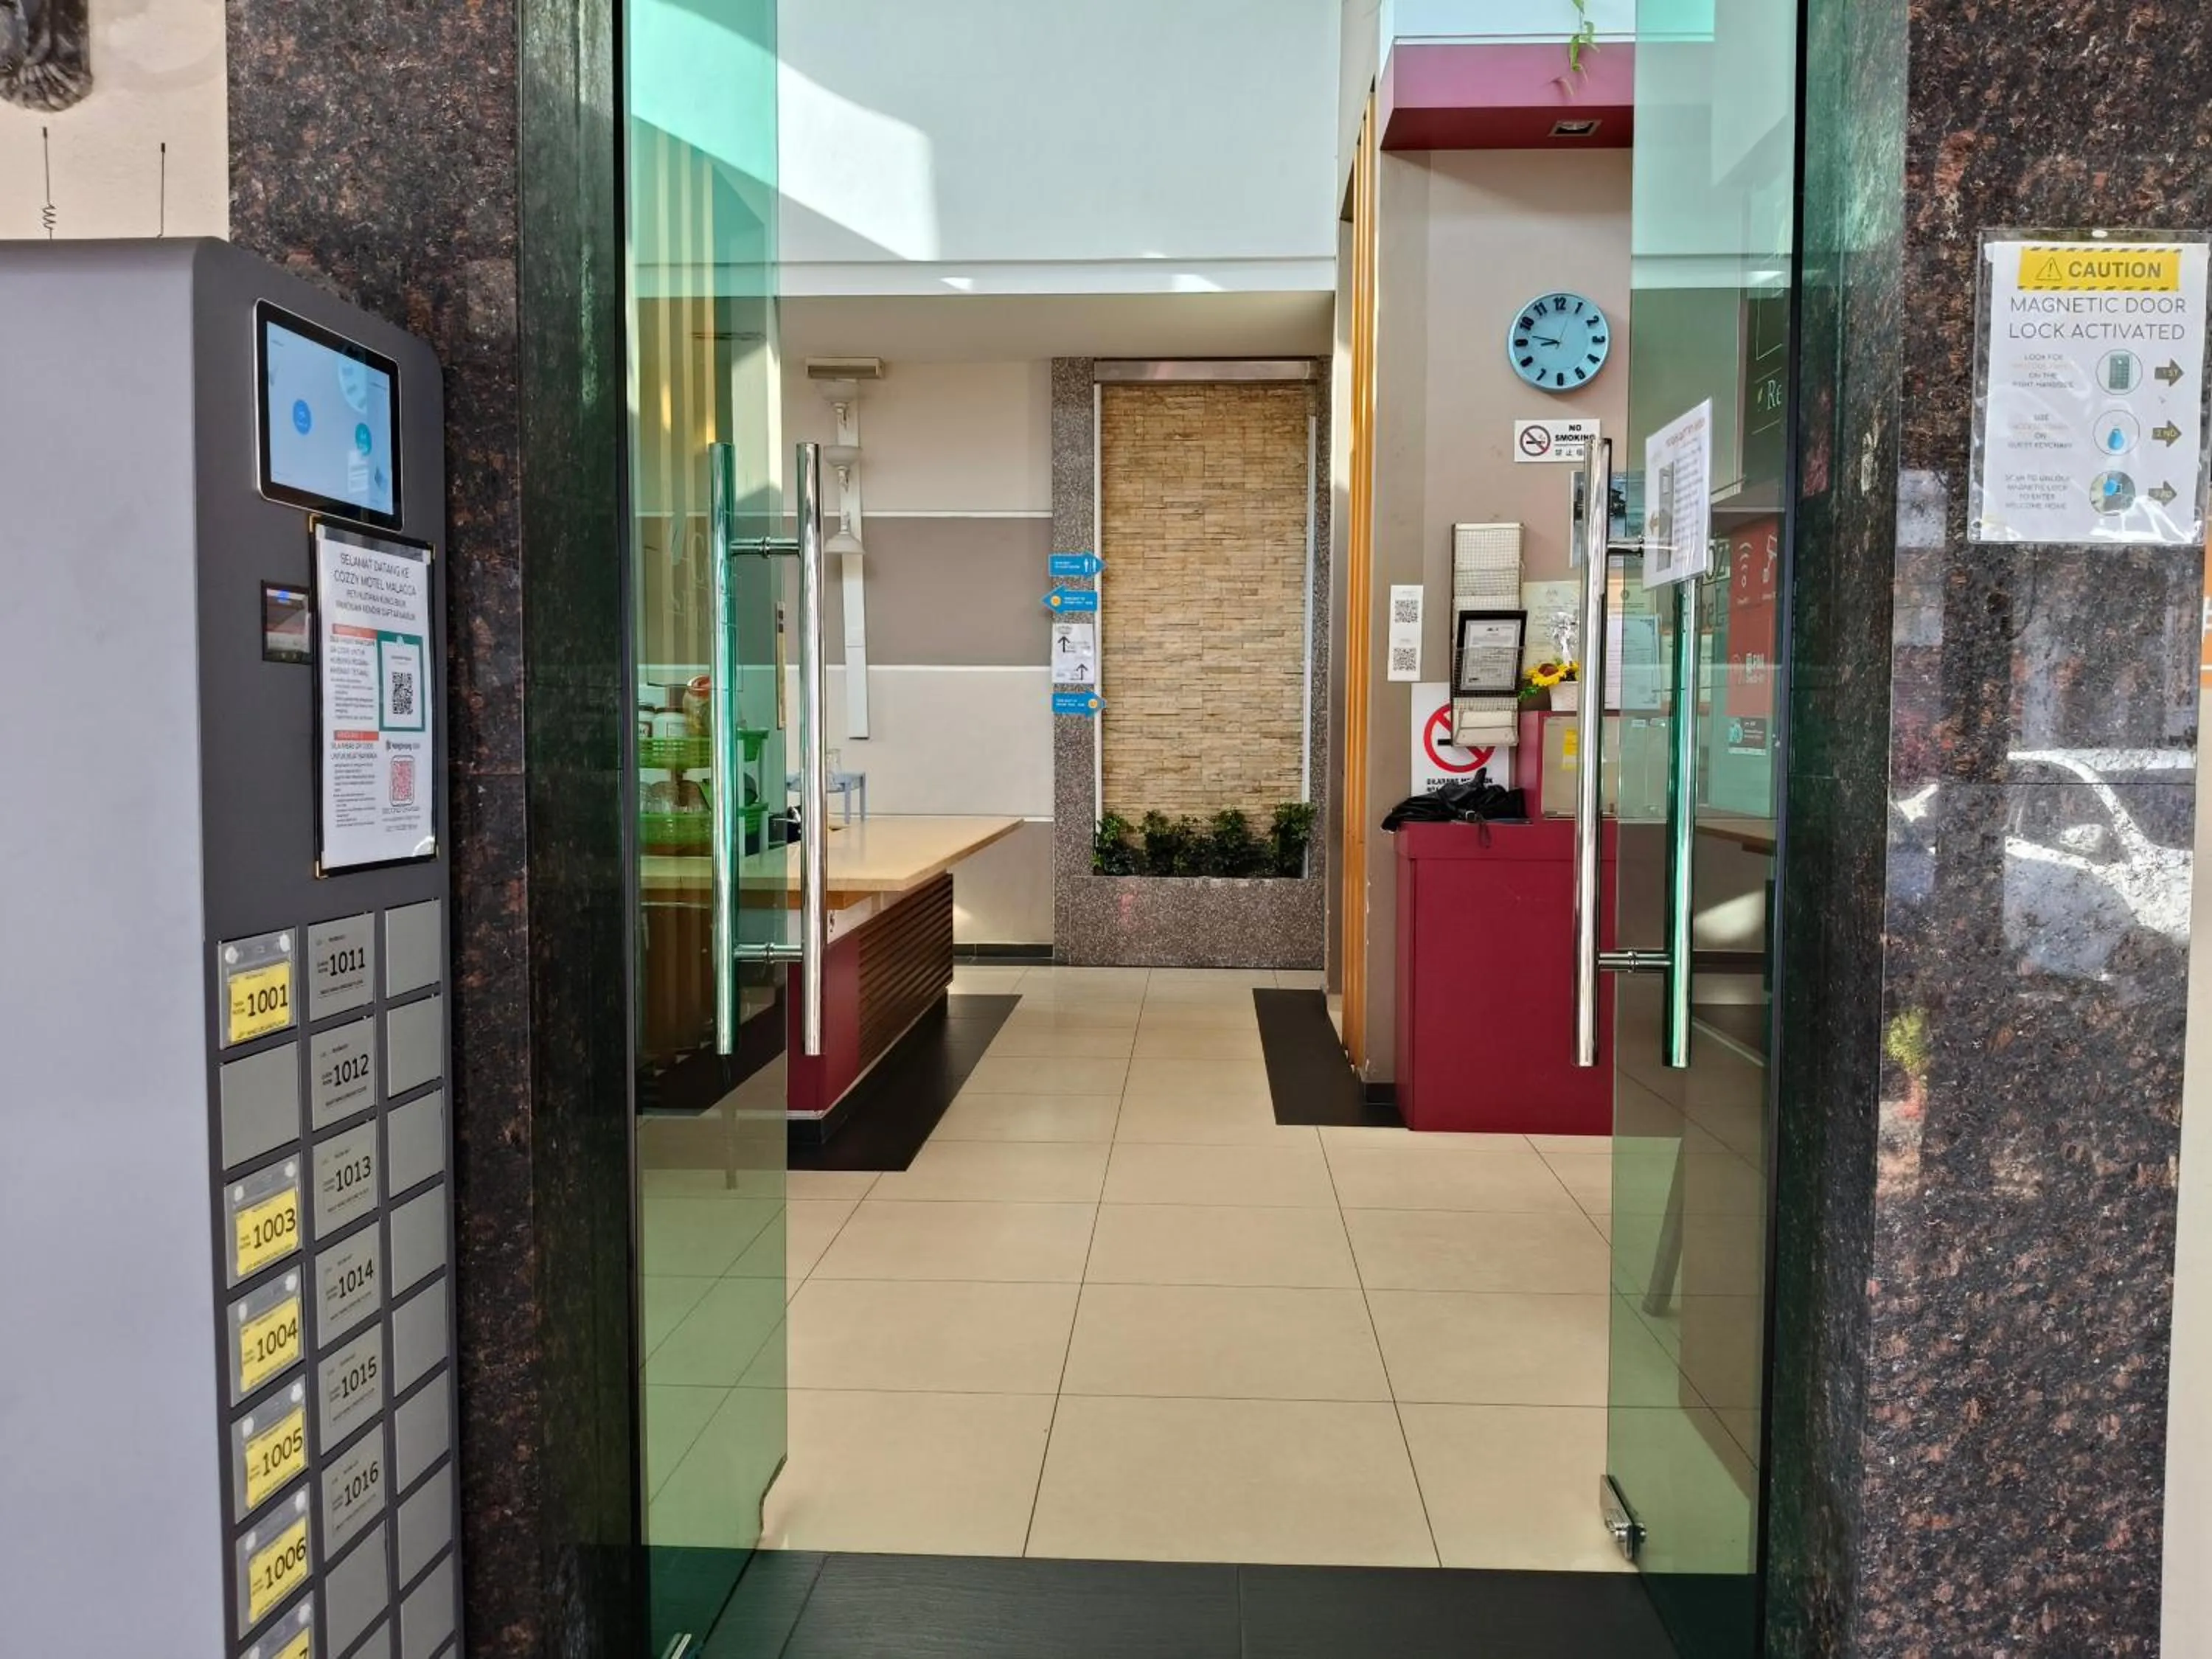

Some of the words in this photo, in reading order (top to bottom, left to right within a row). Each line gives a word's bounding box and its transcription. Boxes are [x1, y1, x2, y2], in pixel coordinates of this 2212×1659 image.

[2067, 260, 2162, 279] CAUTION
[1534, 302, 1548, 316] 11
[1553, 296, 1567, 311] 12
[1574, 302, 1583, 314] 1
[2010, 296, 2118, 313] MAGNETIC
[2125, 297, 2187, 314] DOOR
[1520, 316, 1534, 331] 10
[1586, 316, 1599, 327] 2
[1592, 335, 1605, 344] 3
[2008, 323, 2065, 339] LOCK
[2070, 323, 2185, 341] ACTIVATED
[1587, 353, 1601, 364] 4
[1536, 369, 1546, 381] 7
[1574, 367, 1586, 380] 5
[341, 552, 372, 569] SELAMAT
[333, 570, 359, 585] COZZY
[361, 574, 385, 591] MOTEL
[386, 581, 417, 597] MALACCA
[329, 947, 366, 977] 1011
[246, 984, 288, 1018] 1001
[333, 1053, 369, 1087] 1012
[335, 1155, 372, 1192] 1013
[252, 1207, 296, 1249] 1003
[338, 1259, 375, 1298] 1014
[256, 1317, 298, 1363] 1004
[341, 1355, 378, 1399] 1015
[262, 1427, 304, 1476] 1005
[344, 1461, 379, 1507] 1016
[265, 1537, 306, 1590] 1006
